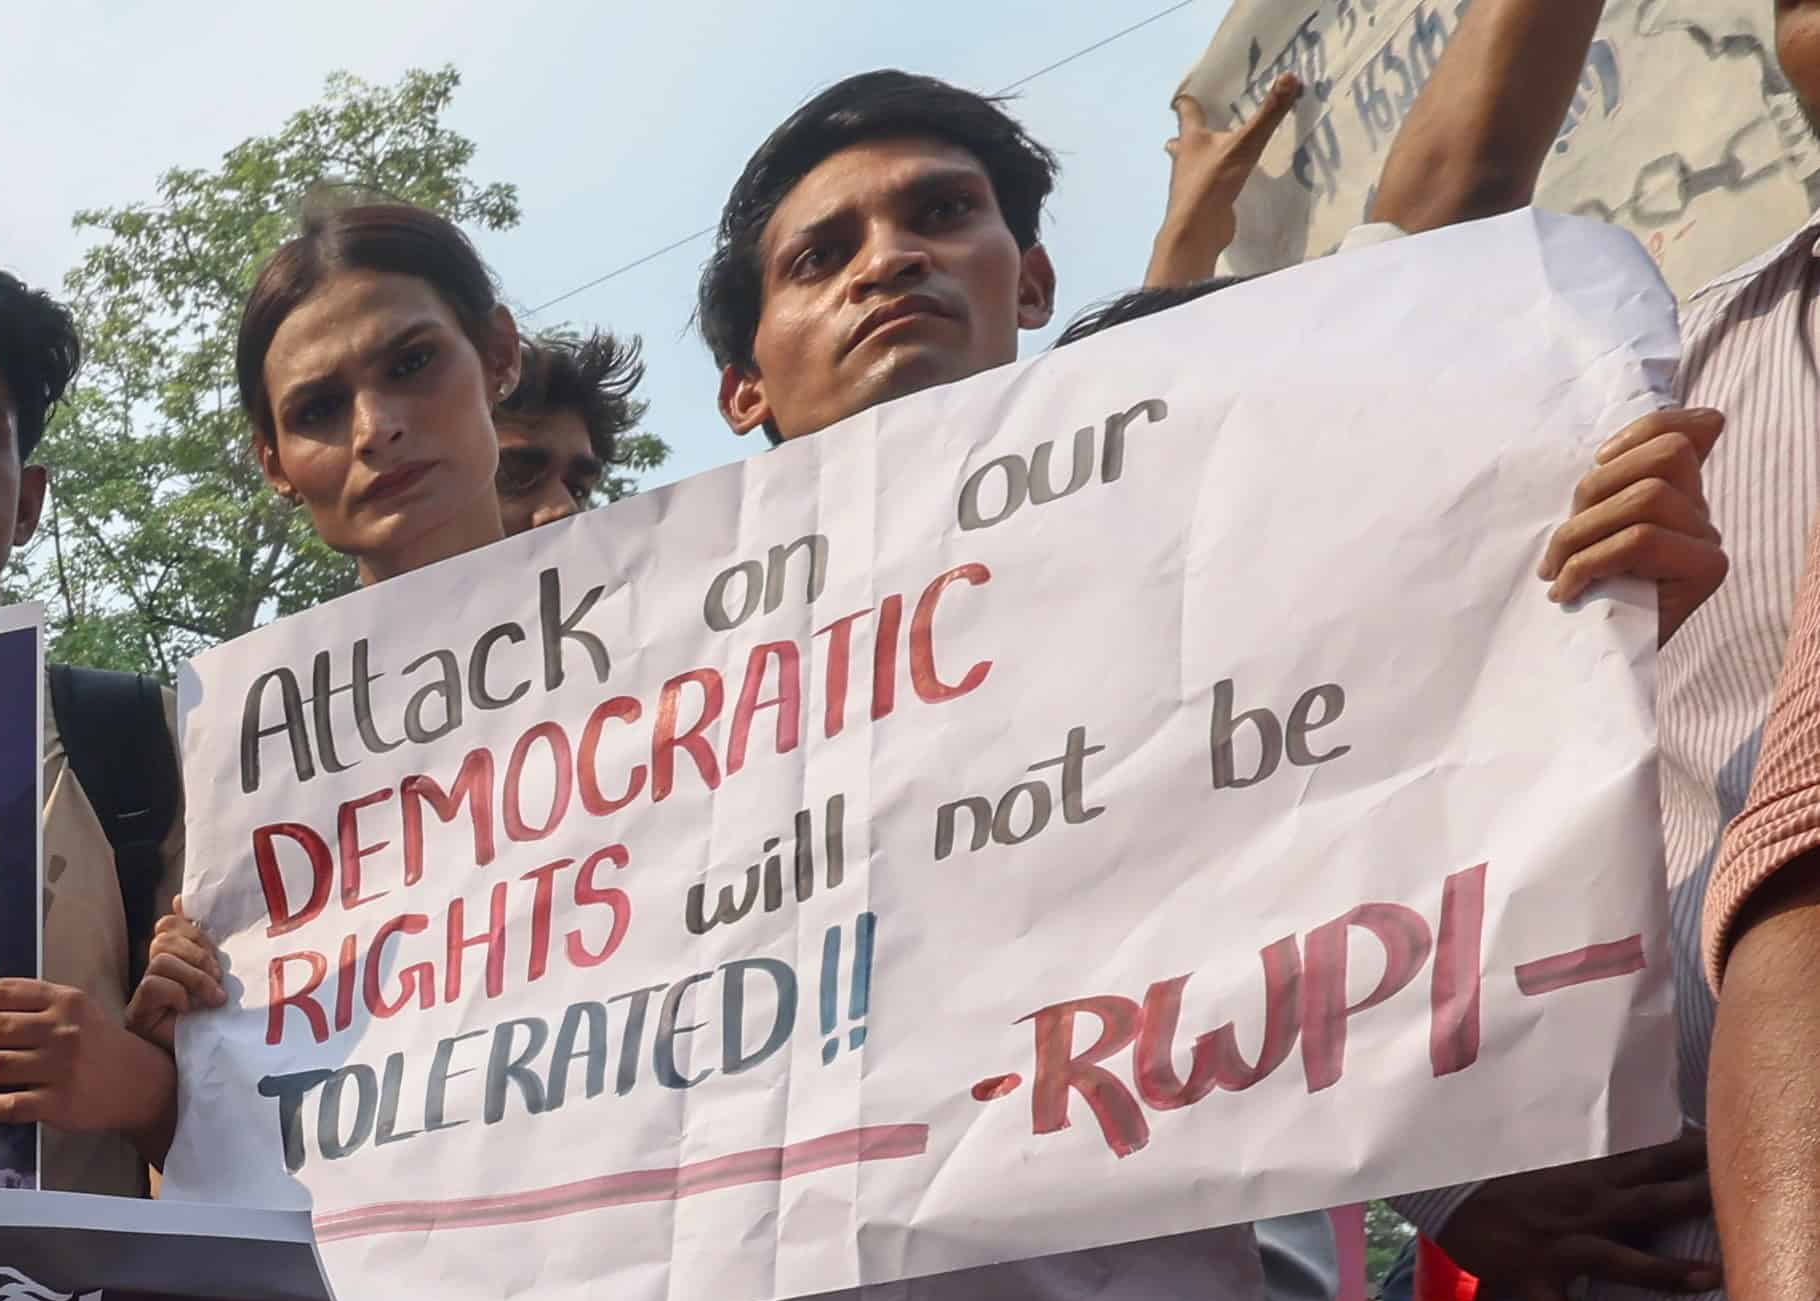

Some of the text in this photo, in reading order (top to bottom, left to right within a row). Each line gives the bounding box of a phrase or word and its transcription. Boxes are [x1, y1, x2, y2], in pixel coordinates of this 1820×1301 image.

[240, 397, 1168, 794] Attack on our
[250, 561, 993, 938] DEMOCRATIC
[257, 910, 878, 1176] TOLERATED!!
[264, 677, 1352, 1047] RIGHTS will not be
